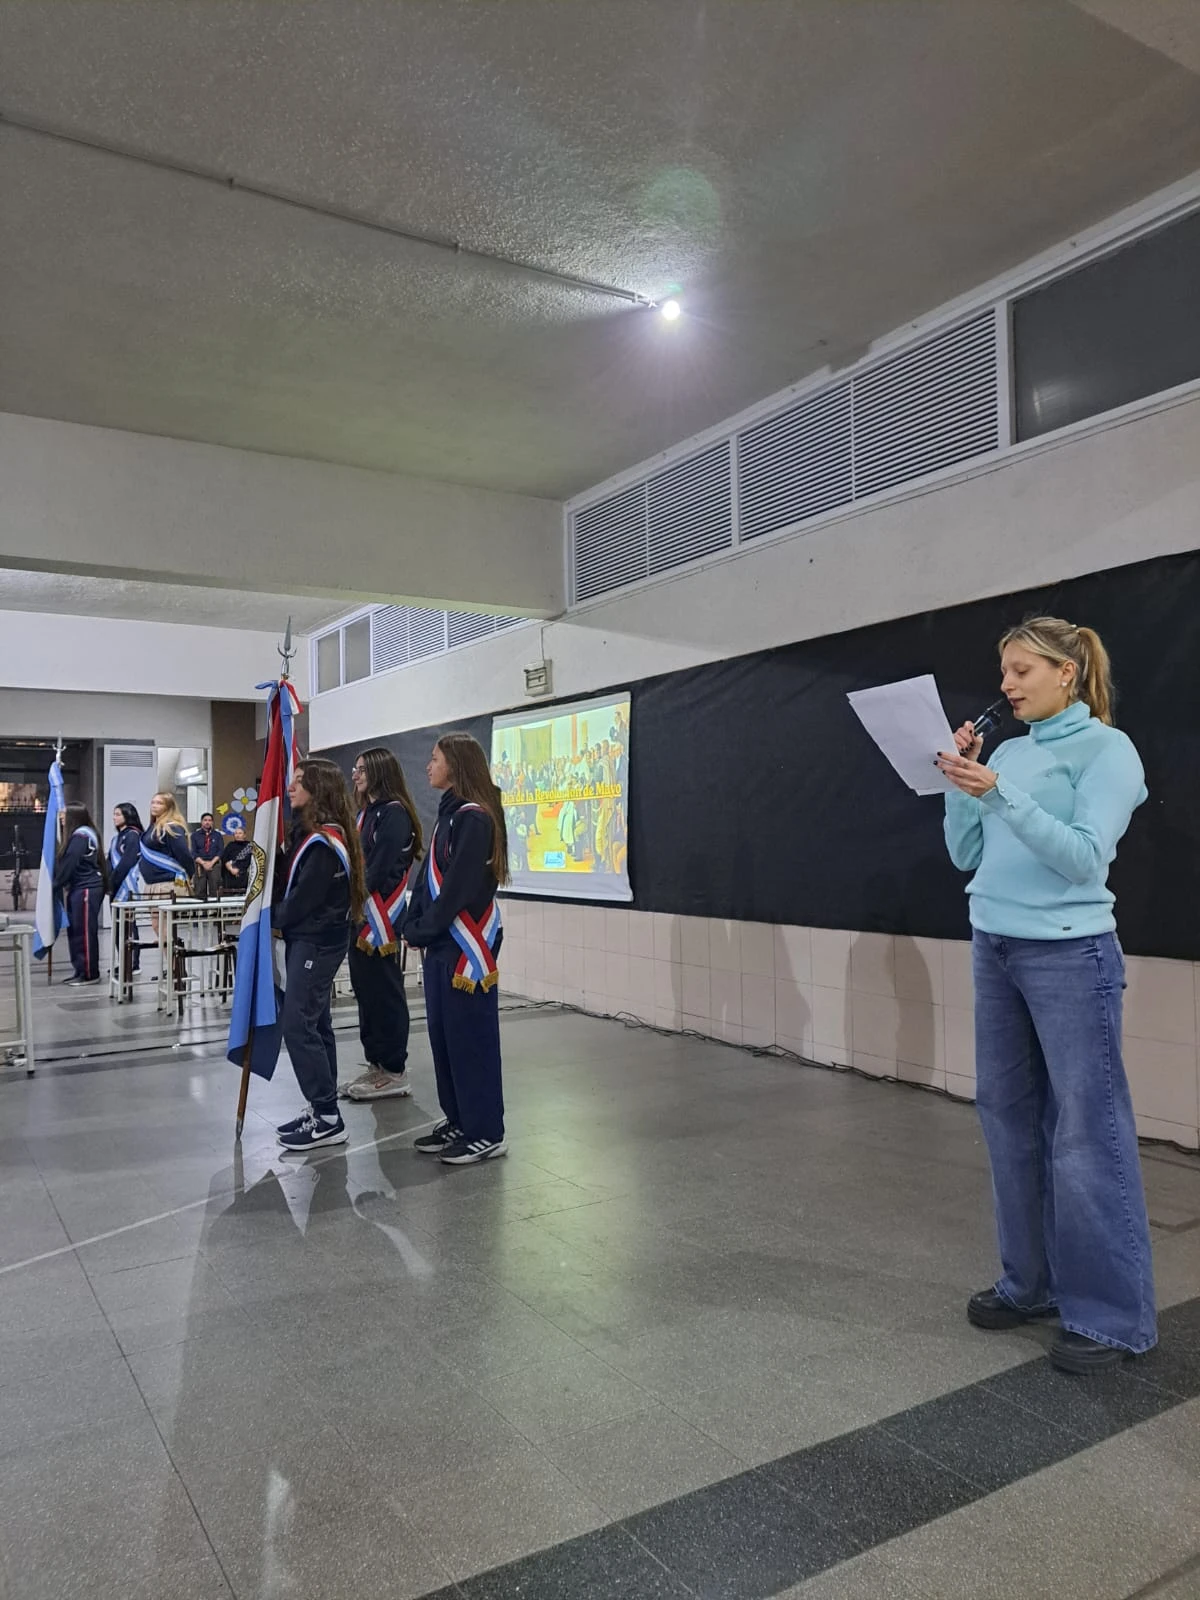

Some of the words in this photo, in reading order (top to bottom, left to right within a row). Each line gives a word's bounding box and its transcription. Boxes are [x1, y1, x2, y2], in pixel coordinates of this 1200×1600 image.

[516, 789, 525, 802] de
[526, 788, 534, 802] la
[583, 783, 594, 796] de
[596, 782, 622, 797] Mayo
